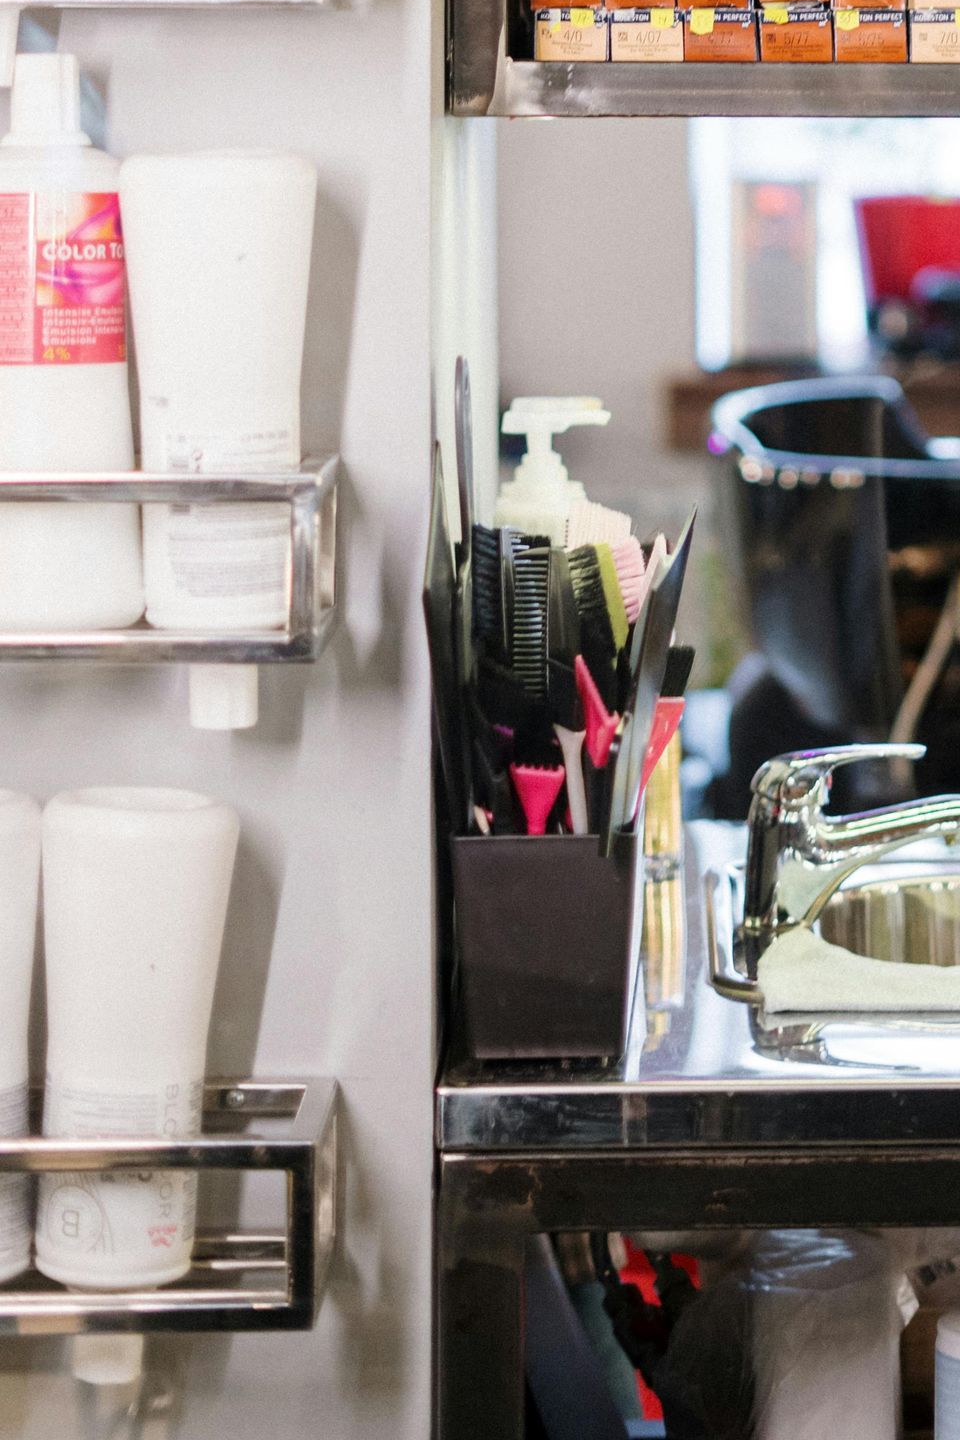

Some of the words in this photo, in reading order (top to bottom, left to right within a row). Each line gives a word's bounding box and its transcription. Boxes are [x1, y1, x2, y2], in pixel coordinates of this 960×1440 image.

[564, 32, 582, 42] 4/0
[636, 32, 660, 43] 4/07
[43, 243, 106, 260] COLOR
[43, 348, 70, 360] 4%
